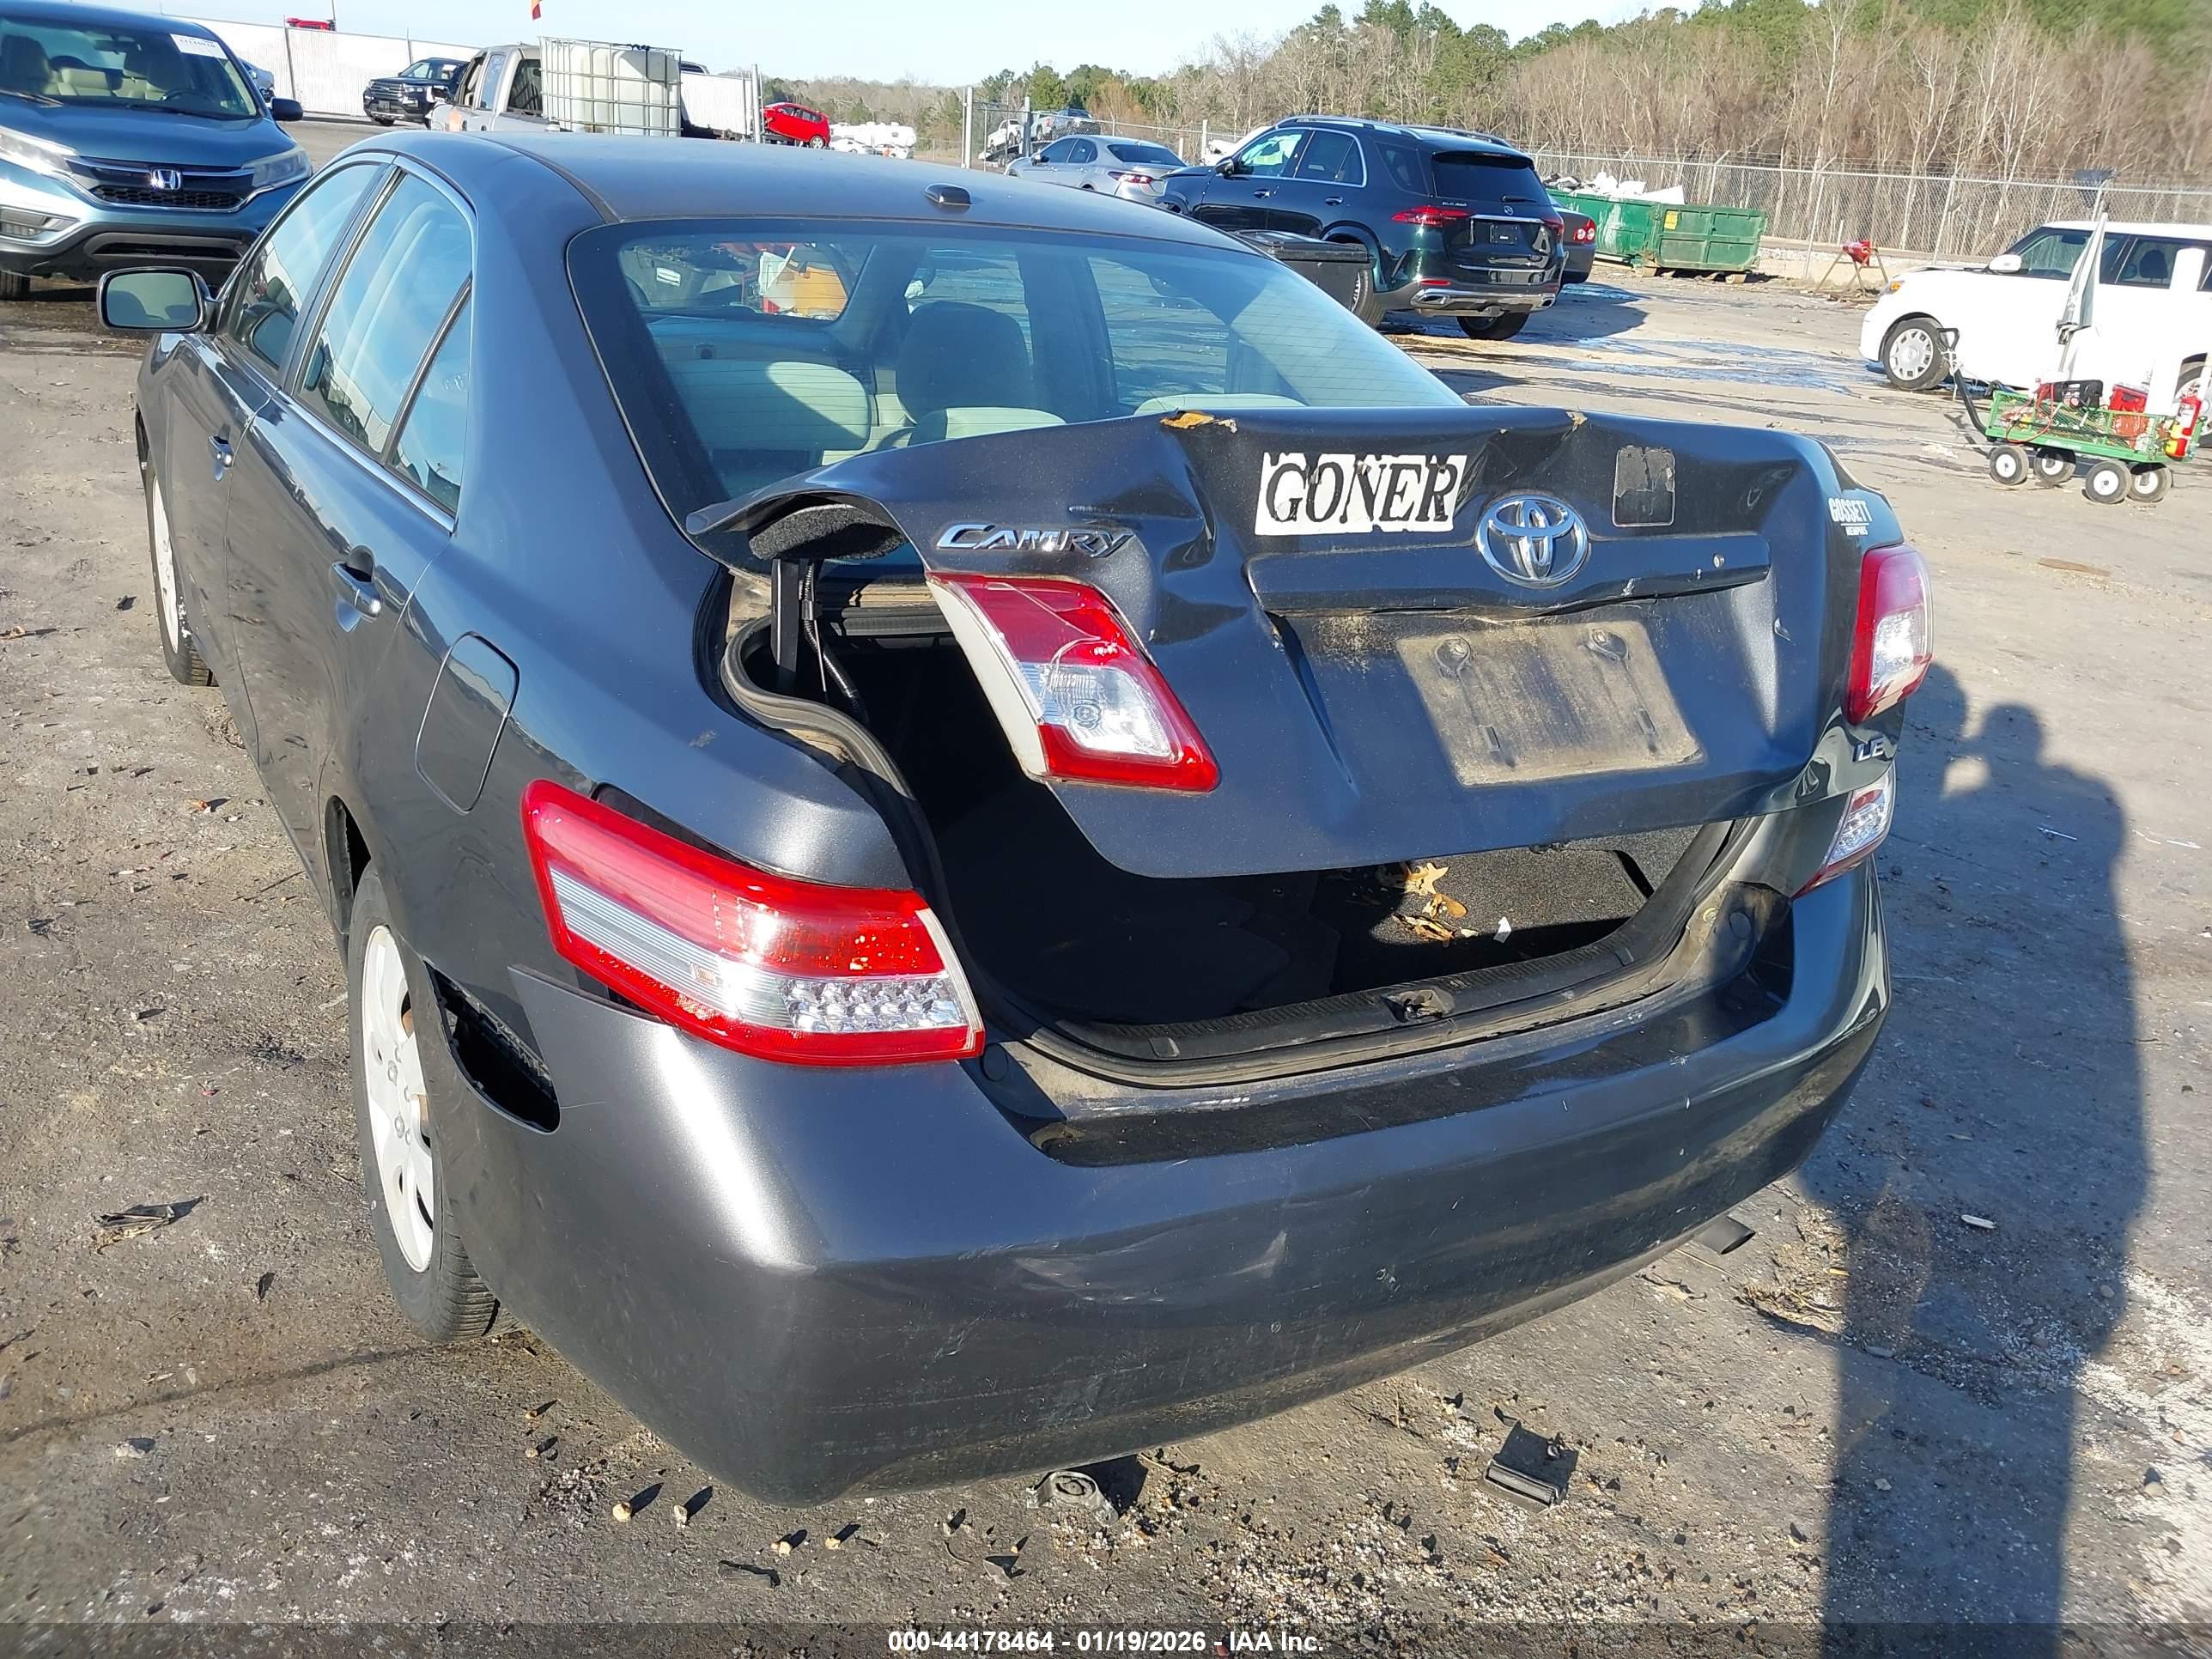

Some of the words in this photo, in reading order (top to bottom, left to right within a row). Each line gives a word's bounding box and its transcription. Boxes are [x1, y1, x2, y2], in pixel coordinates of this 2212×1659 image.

[1266, 461, 1459, 523] GONER
[1827, 497, 1874, 523] GOSSETT
[936, 524, 1134, 558] CAMRY
[1853, 738, 1885, 762] LE
